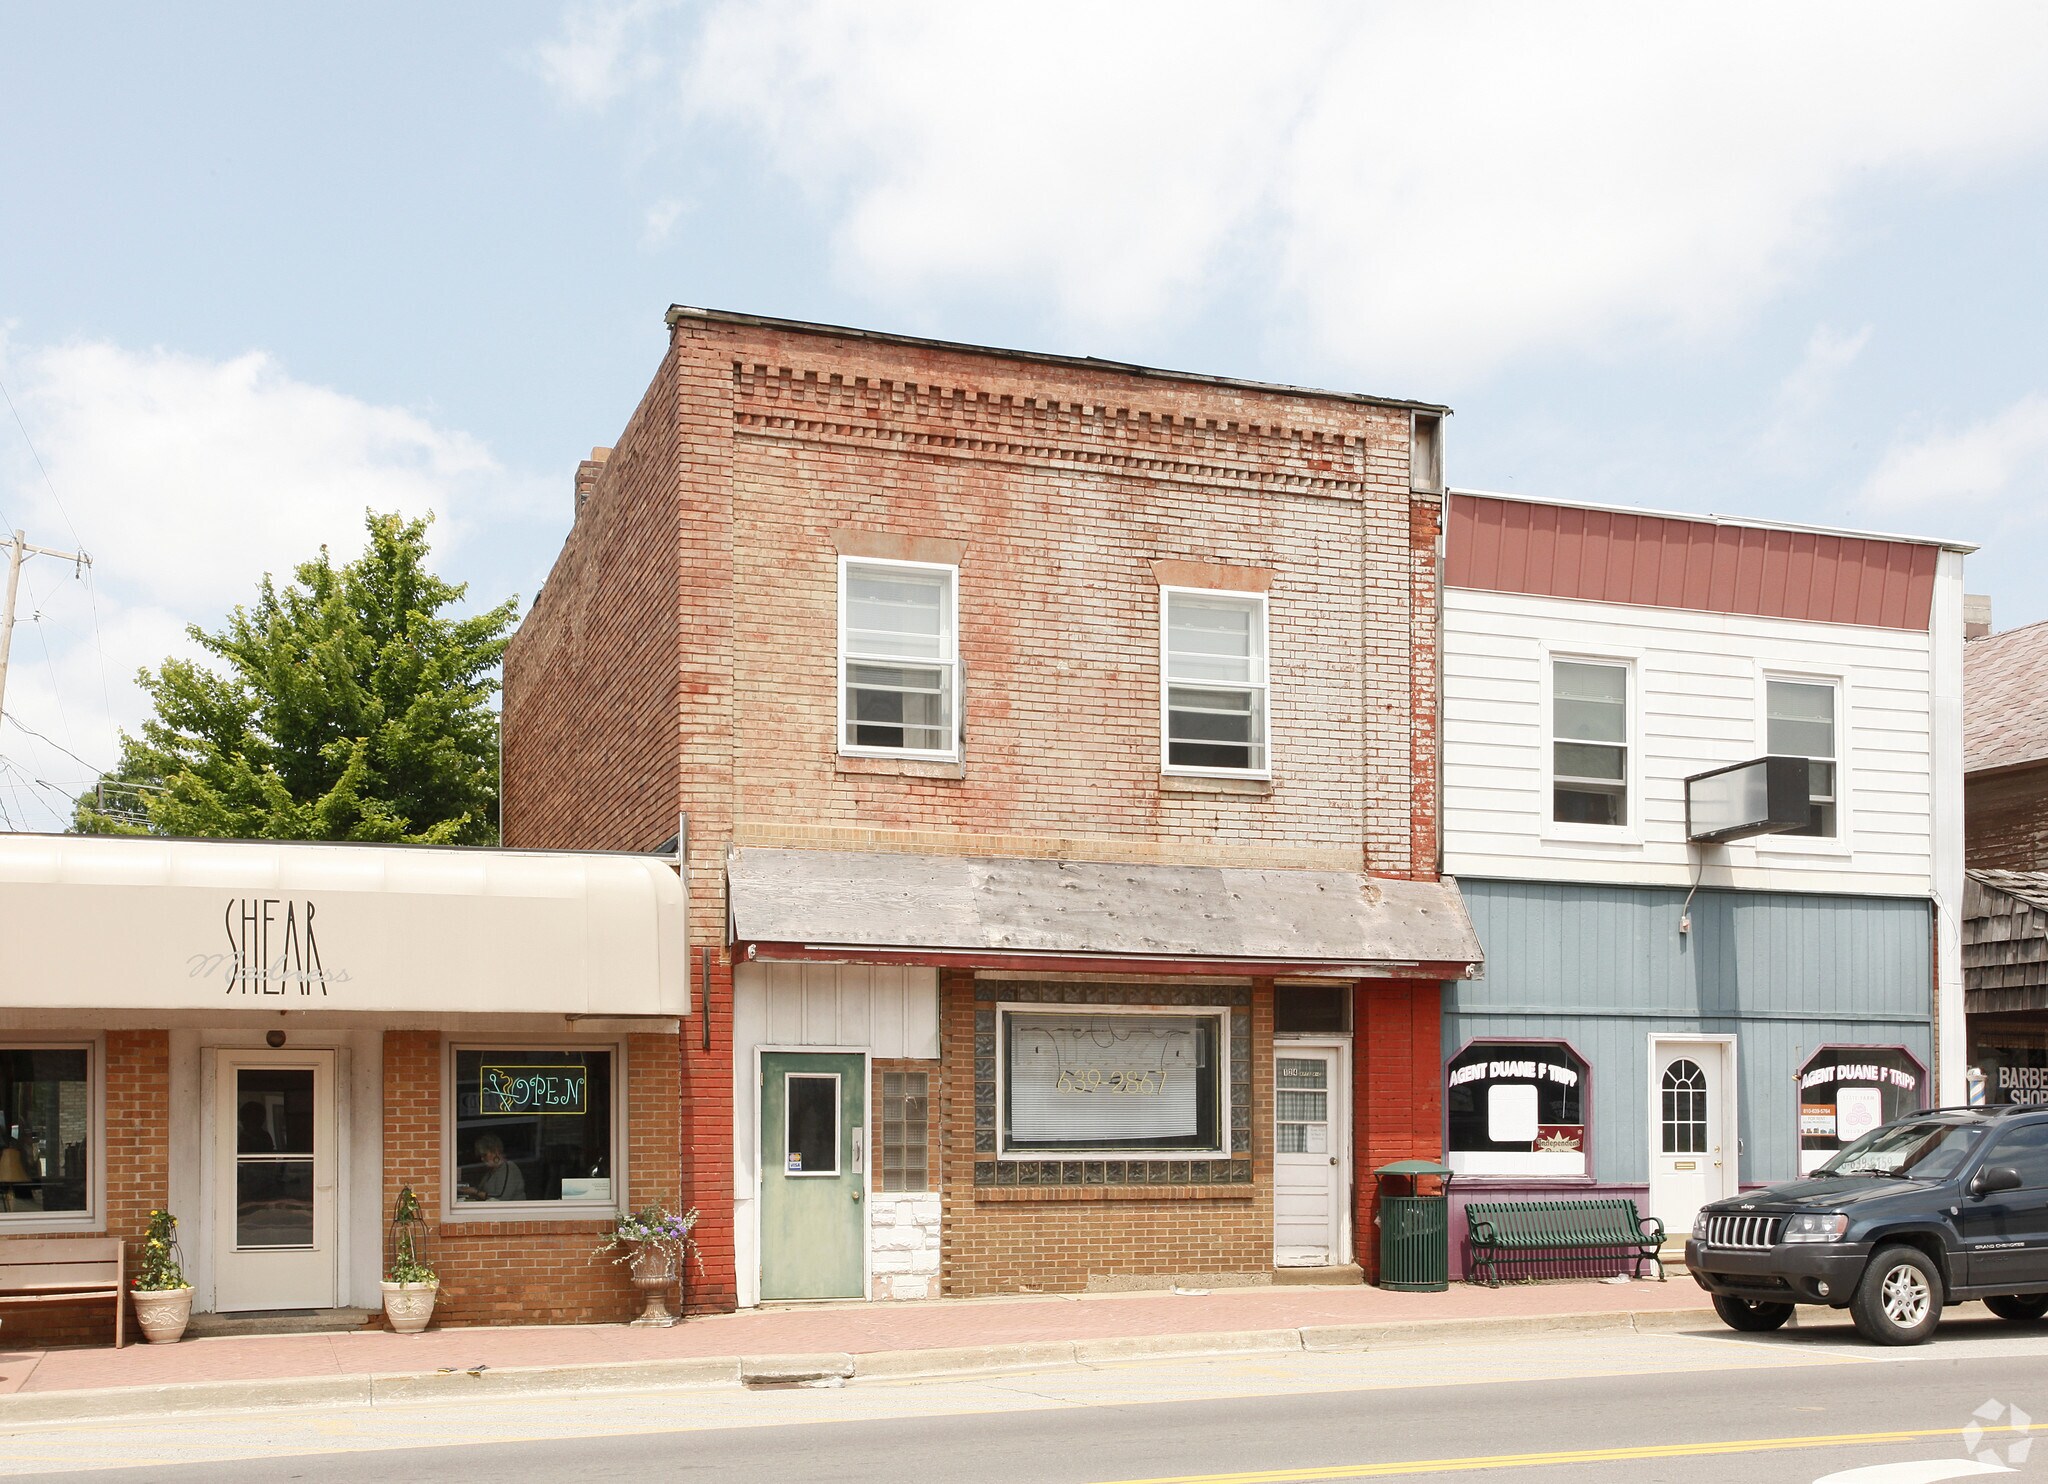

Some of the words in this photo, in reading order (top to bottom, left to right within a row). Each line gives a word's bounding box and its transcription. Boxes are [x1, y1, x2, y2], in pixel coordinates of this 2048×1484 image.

[225, 898, 327, 996] SHEAR
[186, 950, 353, 984] Madness
[1057, 1069, 1167, 1095] 639-2867
[1449, 1062, 1488, 1088] AGENT
[1489, 1061, 1537, 1078] DUANE
[1537, 1063, 1547, 1079] F
[1547, 1064, 1578, 1088] TRIPP
[1801, 1066, 1836, 1089] AGENT
[1836, 1064, 1879, 1081] DUANE
[1880, 1067, 1888, 1082] F
[1889, 1069, 1916, 1091] TRIPP
[511, 1073, 585, 1106] OPEN
[1537, 1138, 1580, 1148] Independent
[1995, 1241, 2025, 1249] CHEROKEE
